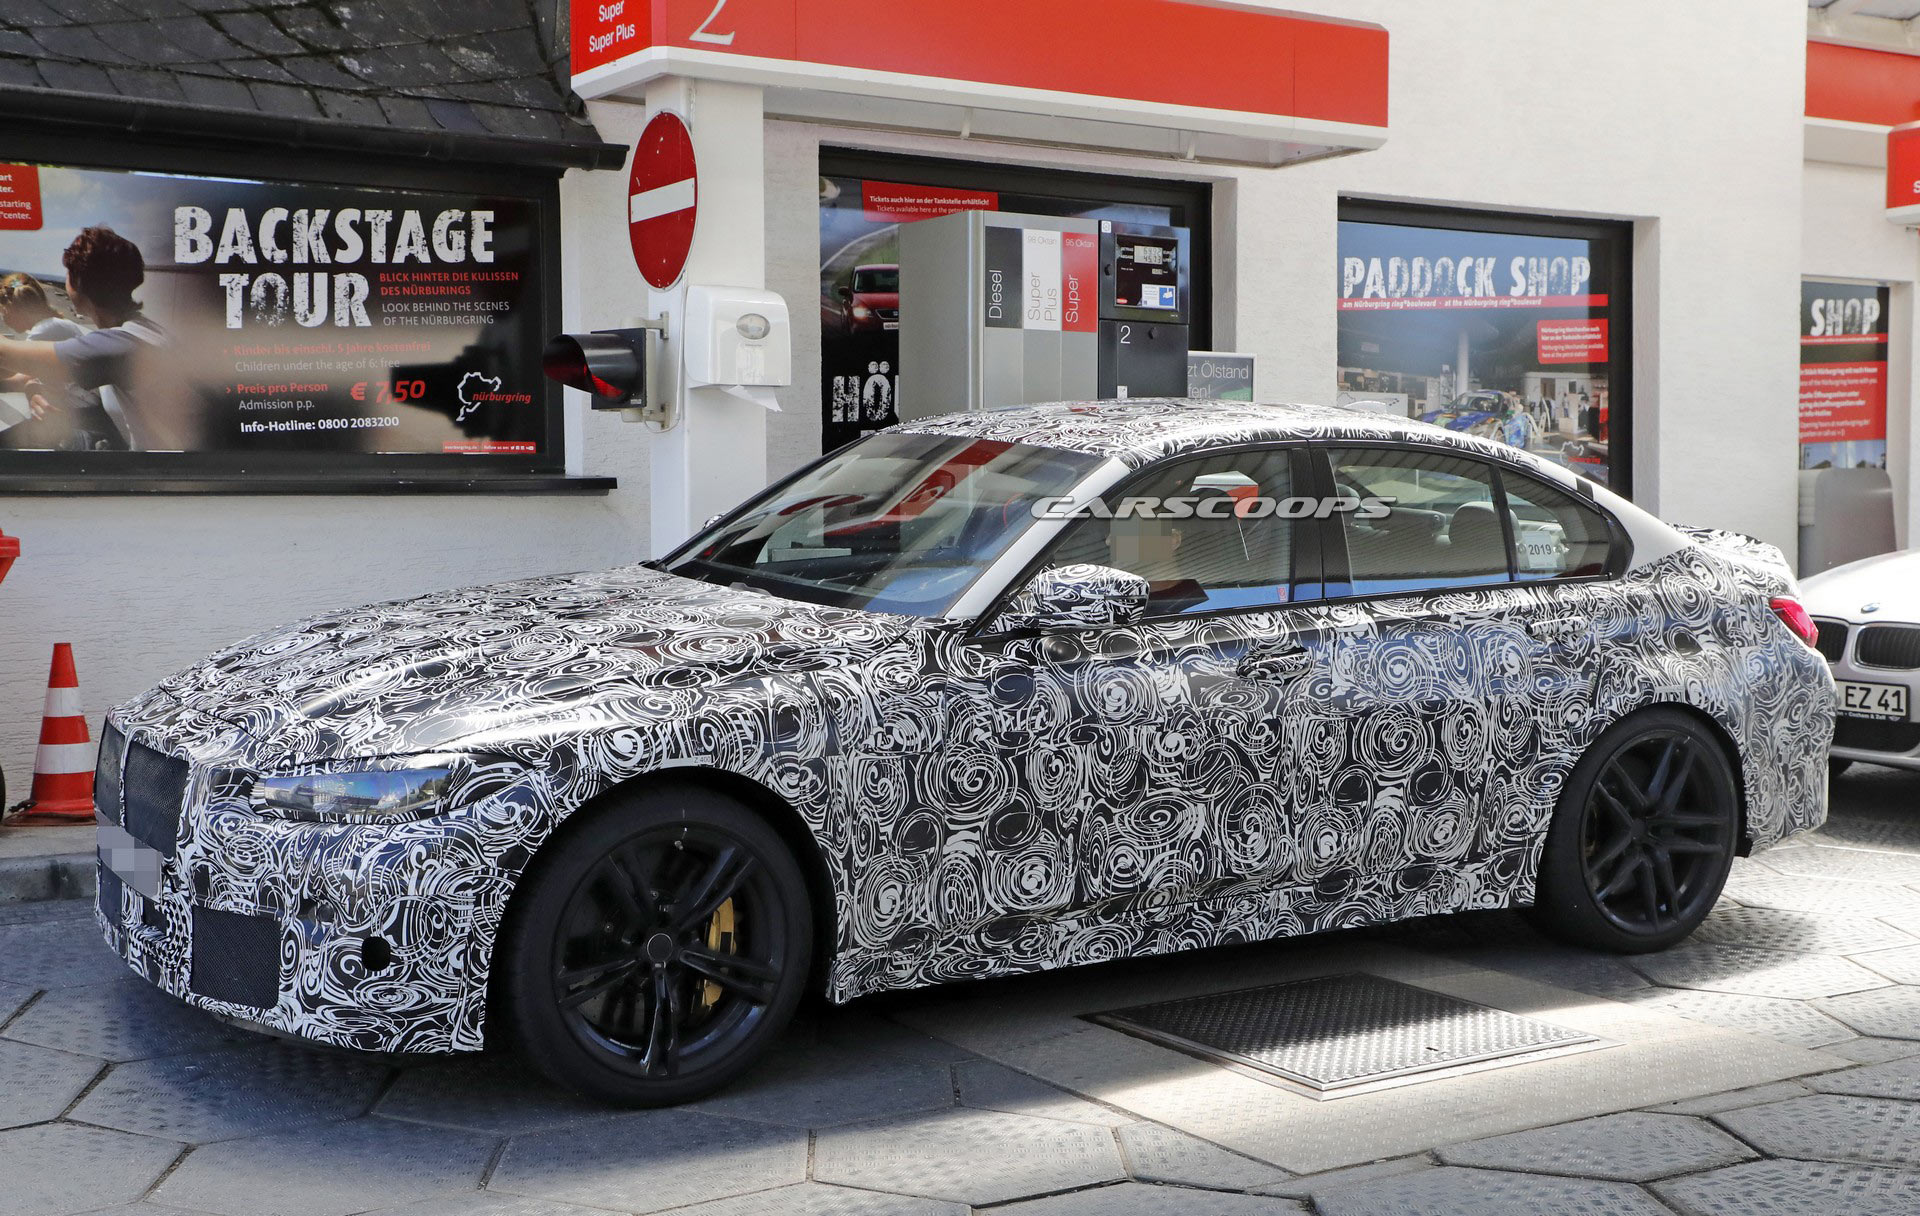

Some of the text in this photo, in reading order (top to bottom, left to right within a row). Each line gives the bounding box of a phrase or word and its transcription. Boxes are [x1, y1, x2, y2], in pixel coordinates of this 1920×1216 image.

[598, 0, 625, 23] Super
[589, 23, 636, 53] Super Plus
[869, 195, 890, 203] Tickets
[934, 197, 961, 205] Tankstelle
[962, 198, 989, 206] erhältlich!
[174, 206, 495, 264] BACKSTAGE
[1075, 239, 1095, 249] Oktan
[379, 271, 519, 282] BLICK HINTER DIE KULISSEN
[1343, 256, 1591, 299] PADDOCK SHOP
[380, 284, 471, 296] DES NÜRBURINGS
[988, 269, 1002, 319] Diesel
[1028, 272, 1043, 321] Super
[1065, 274, 1081, 323] Super
[219, 272, 373, 329] TOUR
[382, 301, 510, 313] LOOK BEHIND THE SCENES
[1044, 288, 1057, 322] Plus
[383, 314, 494, 326] OF THE NÜRBURGRING
[1809, 297, 1881, 336] SHOP
[1120, 325, 1131, 344] 2
[234, 344, 272, 356] Kinder
[275, 344, 293, 355] bis
[338, 343, 343, 353] 5
[376, 341, 431, 353] kostenfrei
[235, 357, 400, 373] Children under the age of 6: free
[1201, 360, 1249, 380] Ölstand
[237, 382, 328, 396] Preis pro Person
[351, 380, 426, 404] € 7,50
[472, 391, 532, 404] nürburgring
[239, 400, 315, 412] Admission p.p.
[240, 416, 400, 433] Info-Hotline: 0800 2083200
[1528, 544, 1552, 555] 2019
[1845, 685, 1904, 713] EZ 41
